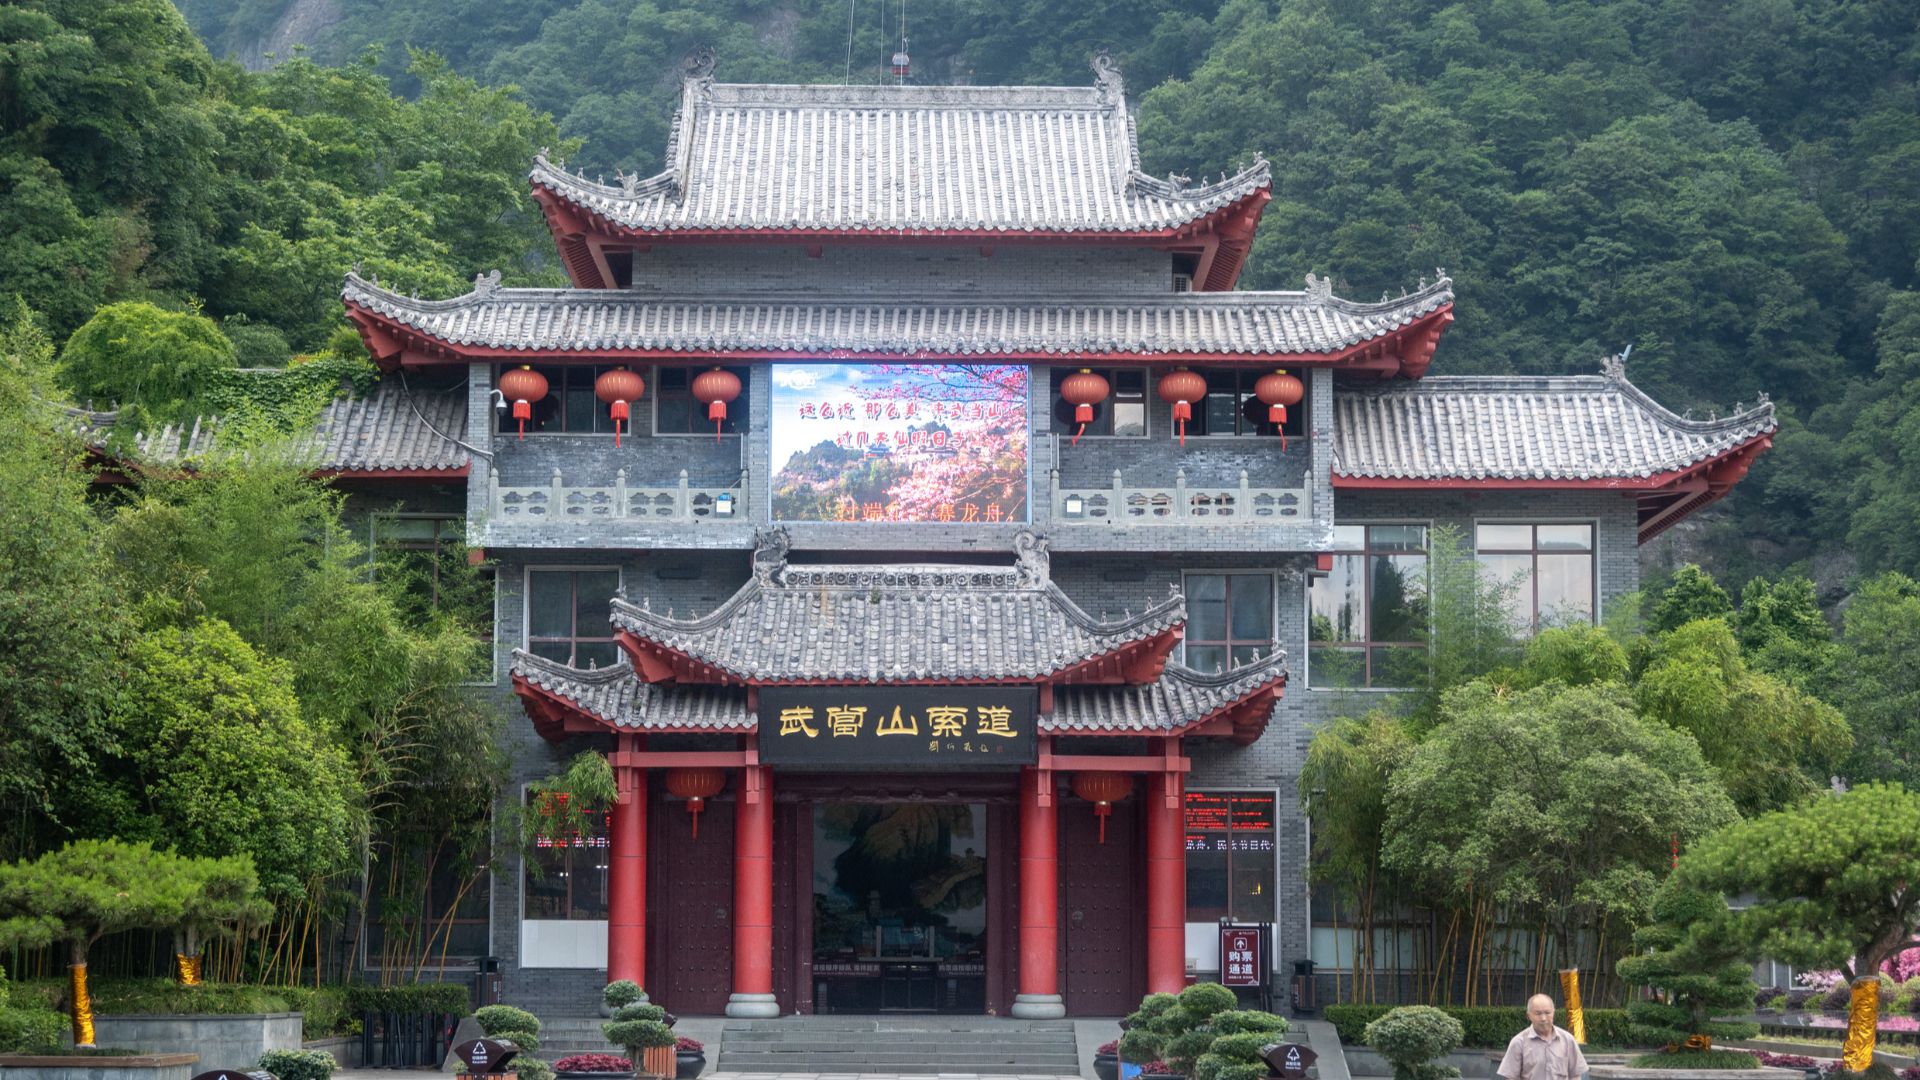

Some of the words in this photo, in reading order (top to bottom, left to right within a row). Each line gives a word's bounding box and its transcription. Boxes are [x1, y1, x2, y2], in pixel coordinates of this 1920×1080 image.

[799, 402, 856, 420] 这么近
[862, 402, 921, 421] 那么美
[932, 402, 1003, 421] 来武当山
[779, 704, 1018, 738] 武當山索道
[1229, 951, 1253, 962] 购票
[1229, 963, 1253, 974] 通道
